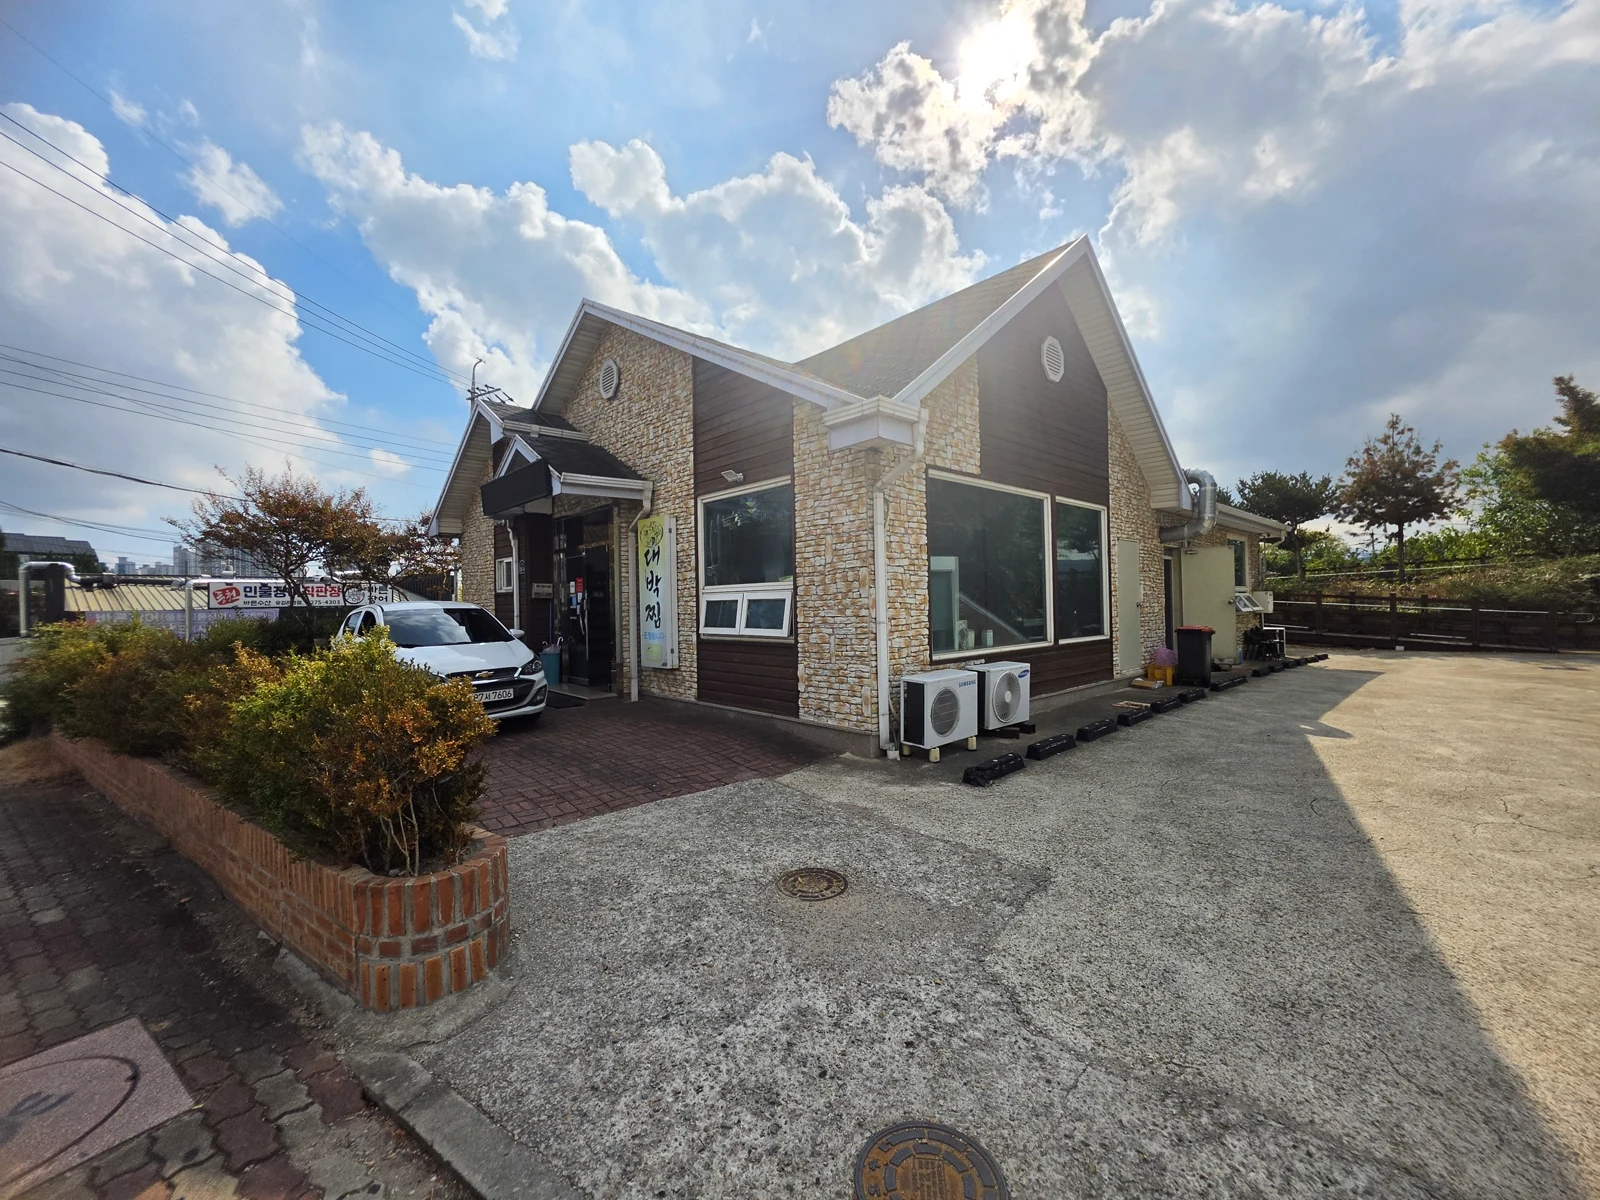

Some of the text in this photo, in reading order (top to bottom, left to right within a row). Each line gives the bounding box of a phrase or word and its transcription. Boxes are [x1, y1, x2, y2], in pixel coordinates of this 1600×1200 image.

[243, 585, 302, 598] 민물장
[643, 545, 663, 629] 대박찜
[492, 690, 513, 699] 7606
